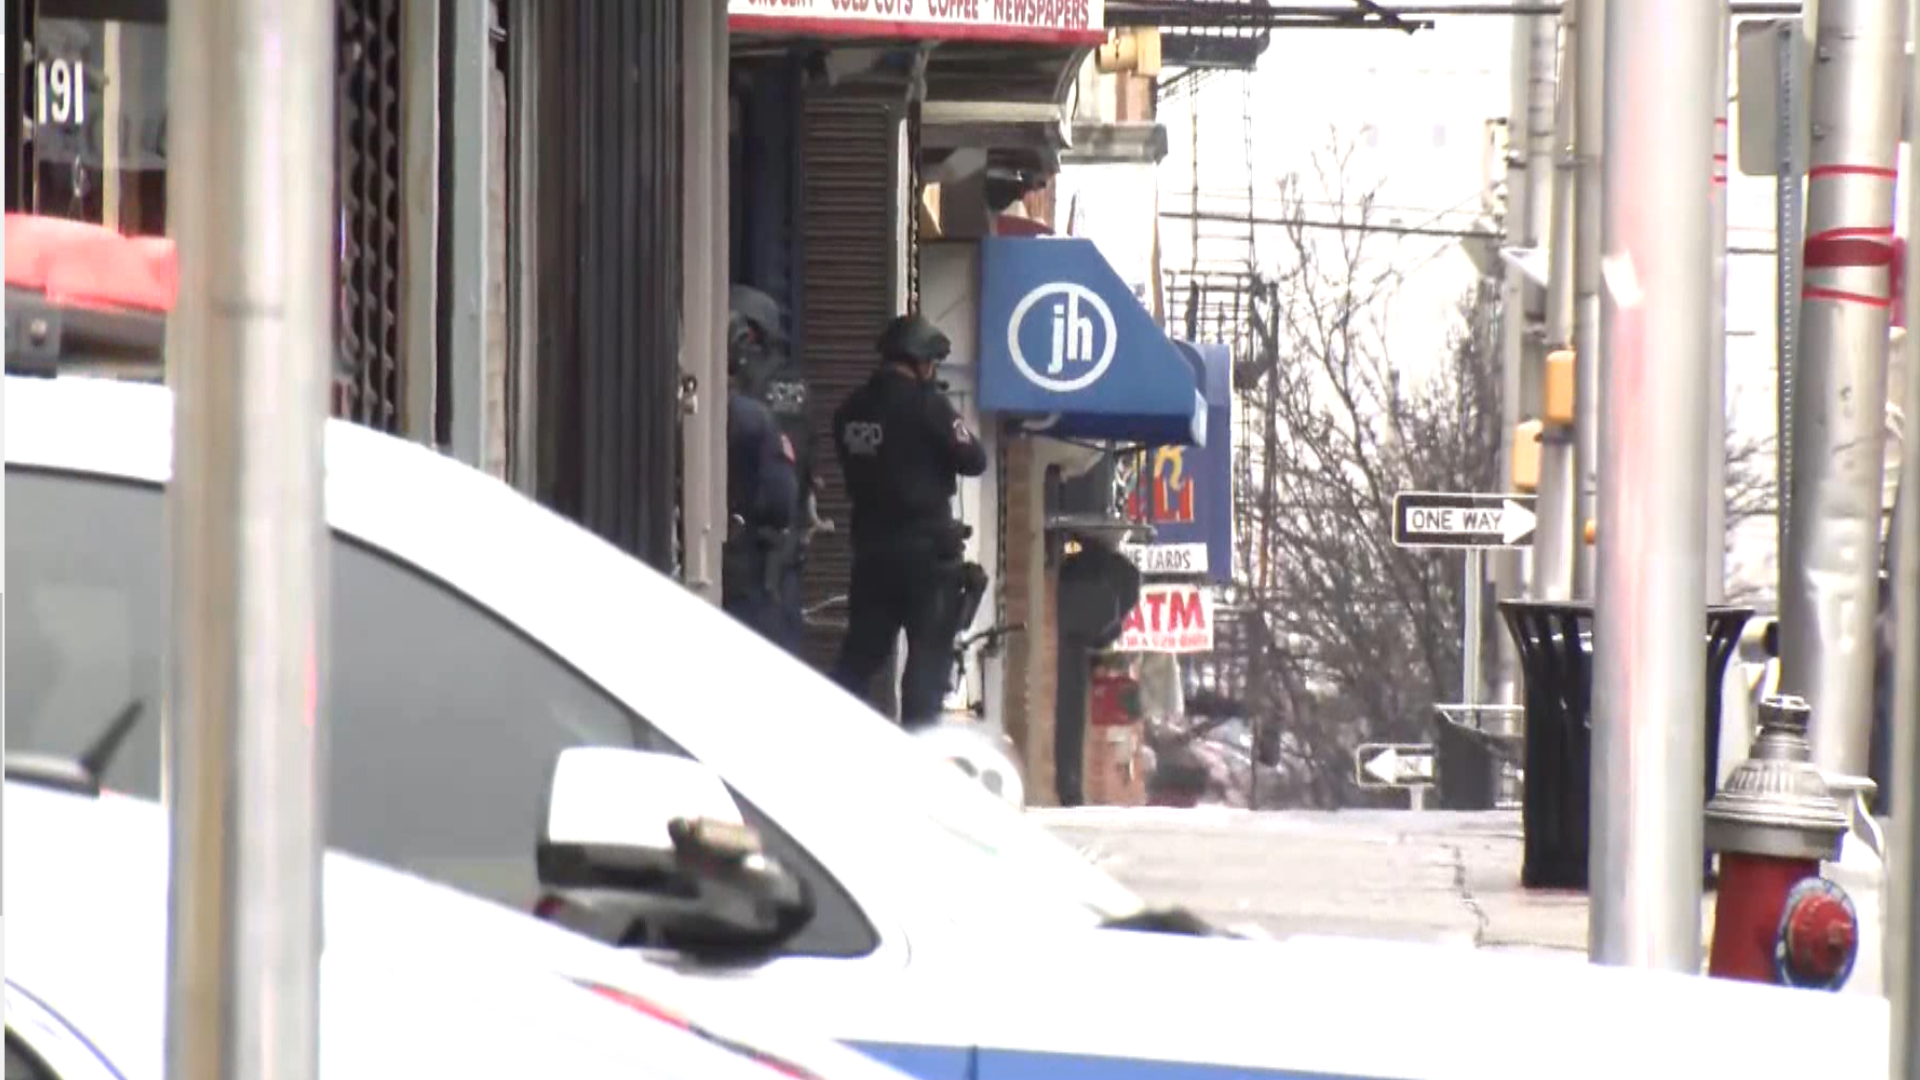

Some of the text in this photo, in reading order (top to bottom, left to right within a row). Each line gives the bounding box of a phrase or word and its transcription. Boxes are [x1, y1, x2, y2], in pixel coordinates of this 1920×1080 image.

[994, 0, 1089, 30] NEWSPAPERS
[38, 59, 84, 124] 191
[1412, 510, 1501, 531] ONE WAY
[1122, 592, 1206, 634] ATM
